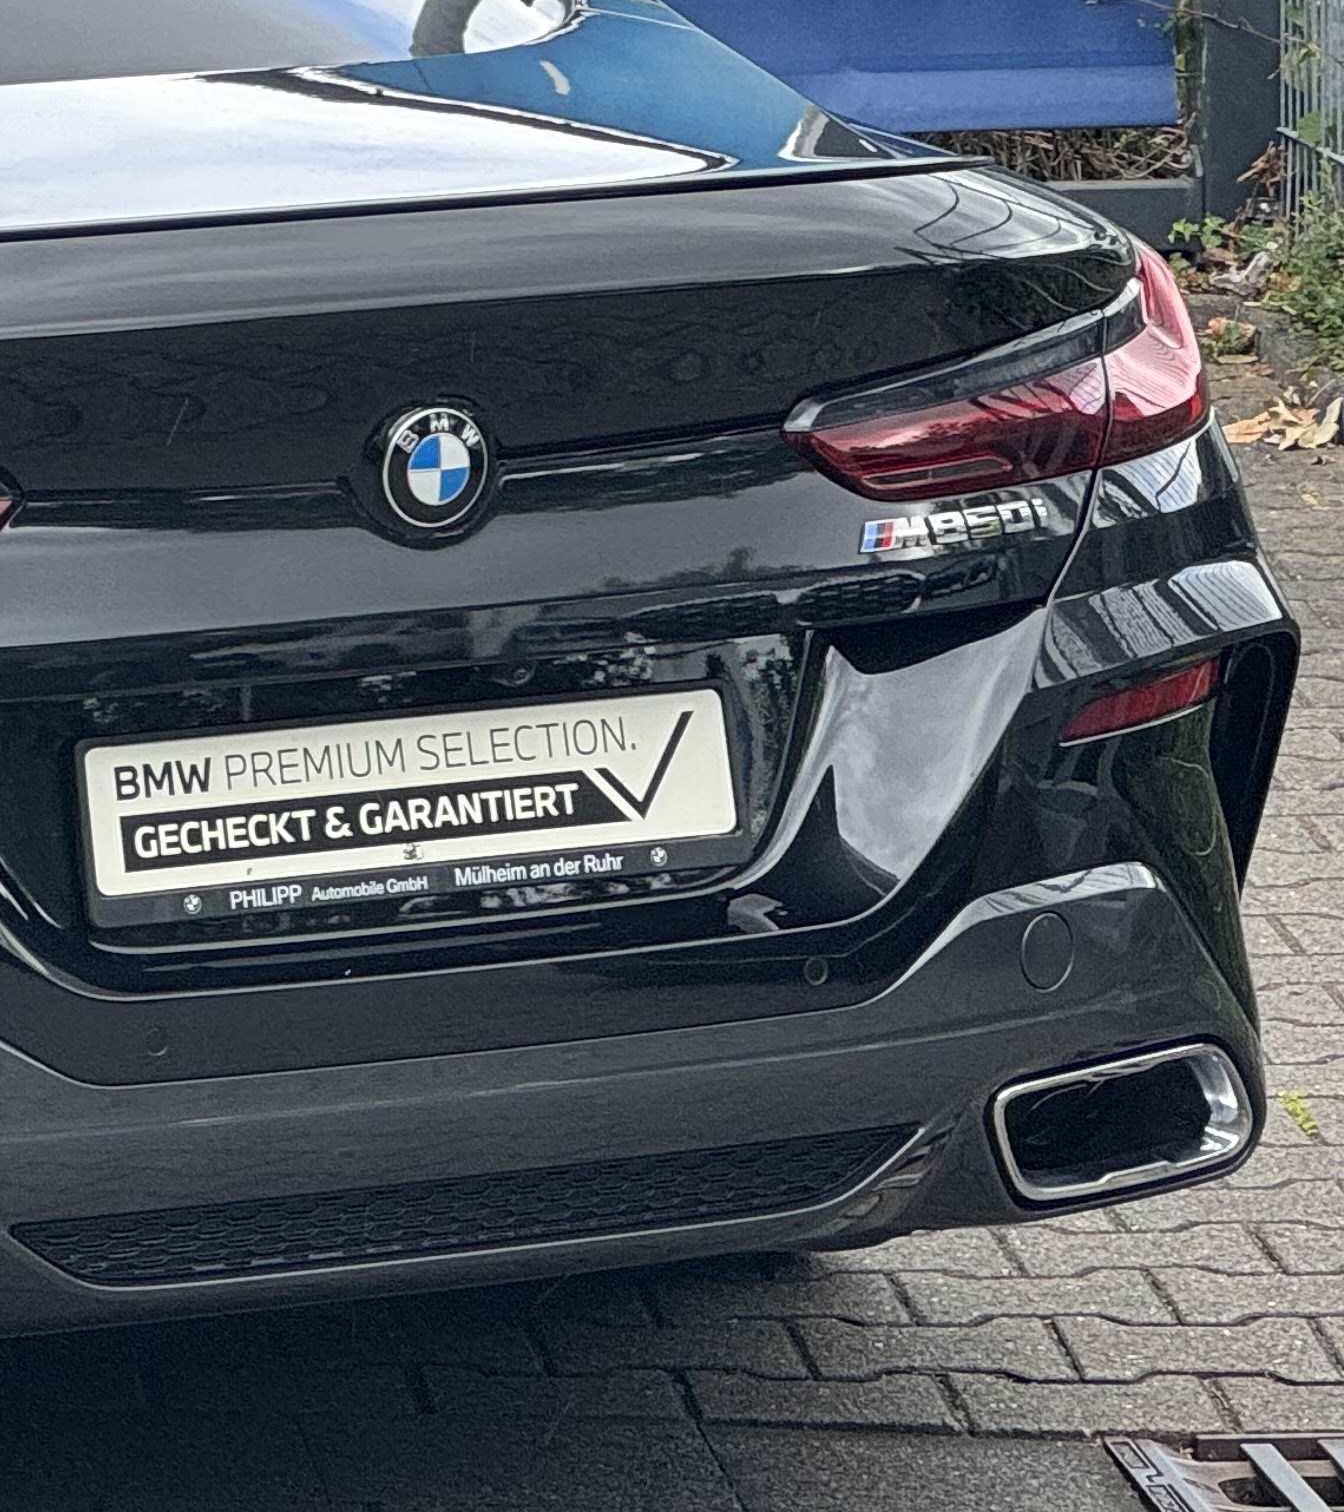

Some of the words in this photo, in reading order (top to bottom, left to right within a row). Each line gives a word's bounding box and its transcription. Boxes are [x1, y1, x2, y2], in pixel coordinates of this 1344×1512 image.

[395, 411, 481, 454] BMW
[113, 756, 212, 801] BMW
[224, 738, 407, 791] PREMIUM
[416, 716, 637, 771] SELECTION.
[133, 808, 317, 859] GECHECKT
[324, 805, 354, 840] &
[358, 782, 580, 836] GARANTIERT
[229, 884, 303, 909] PHILIPP
[311, 879, 385, 903] Automobile
[386, 874, 429, 894] GmbH
[454, 863, 526, 887] Mülheim
[530, 862, 551, 878] an
[555, 857, 582, 876] der
[583, 852, 625, 874] Ruhr
